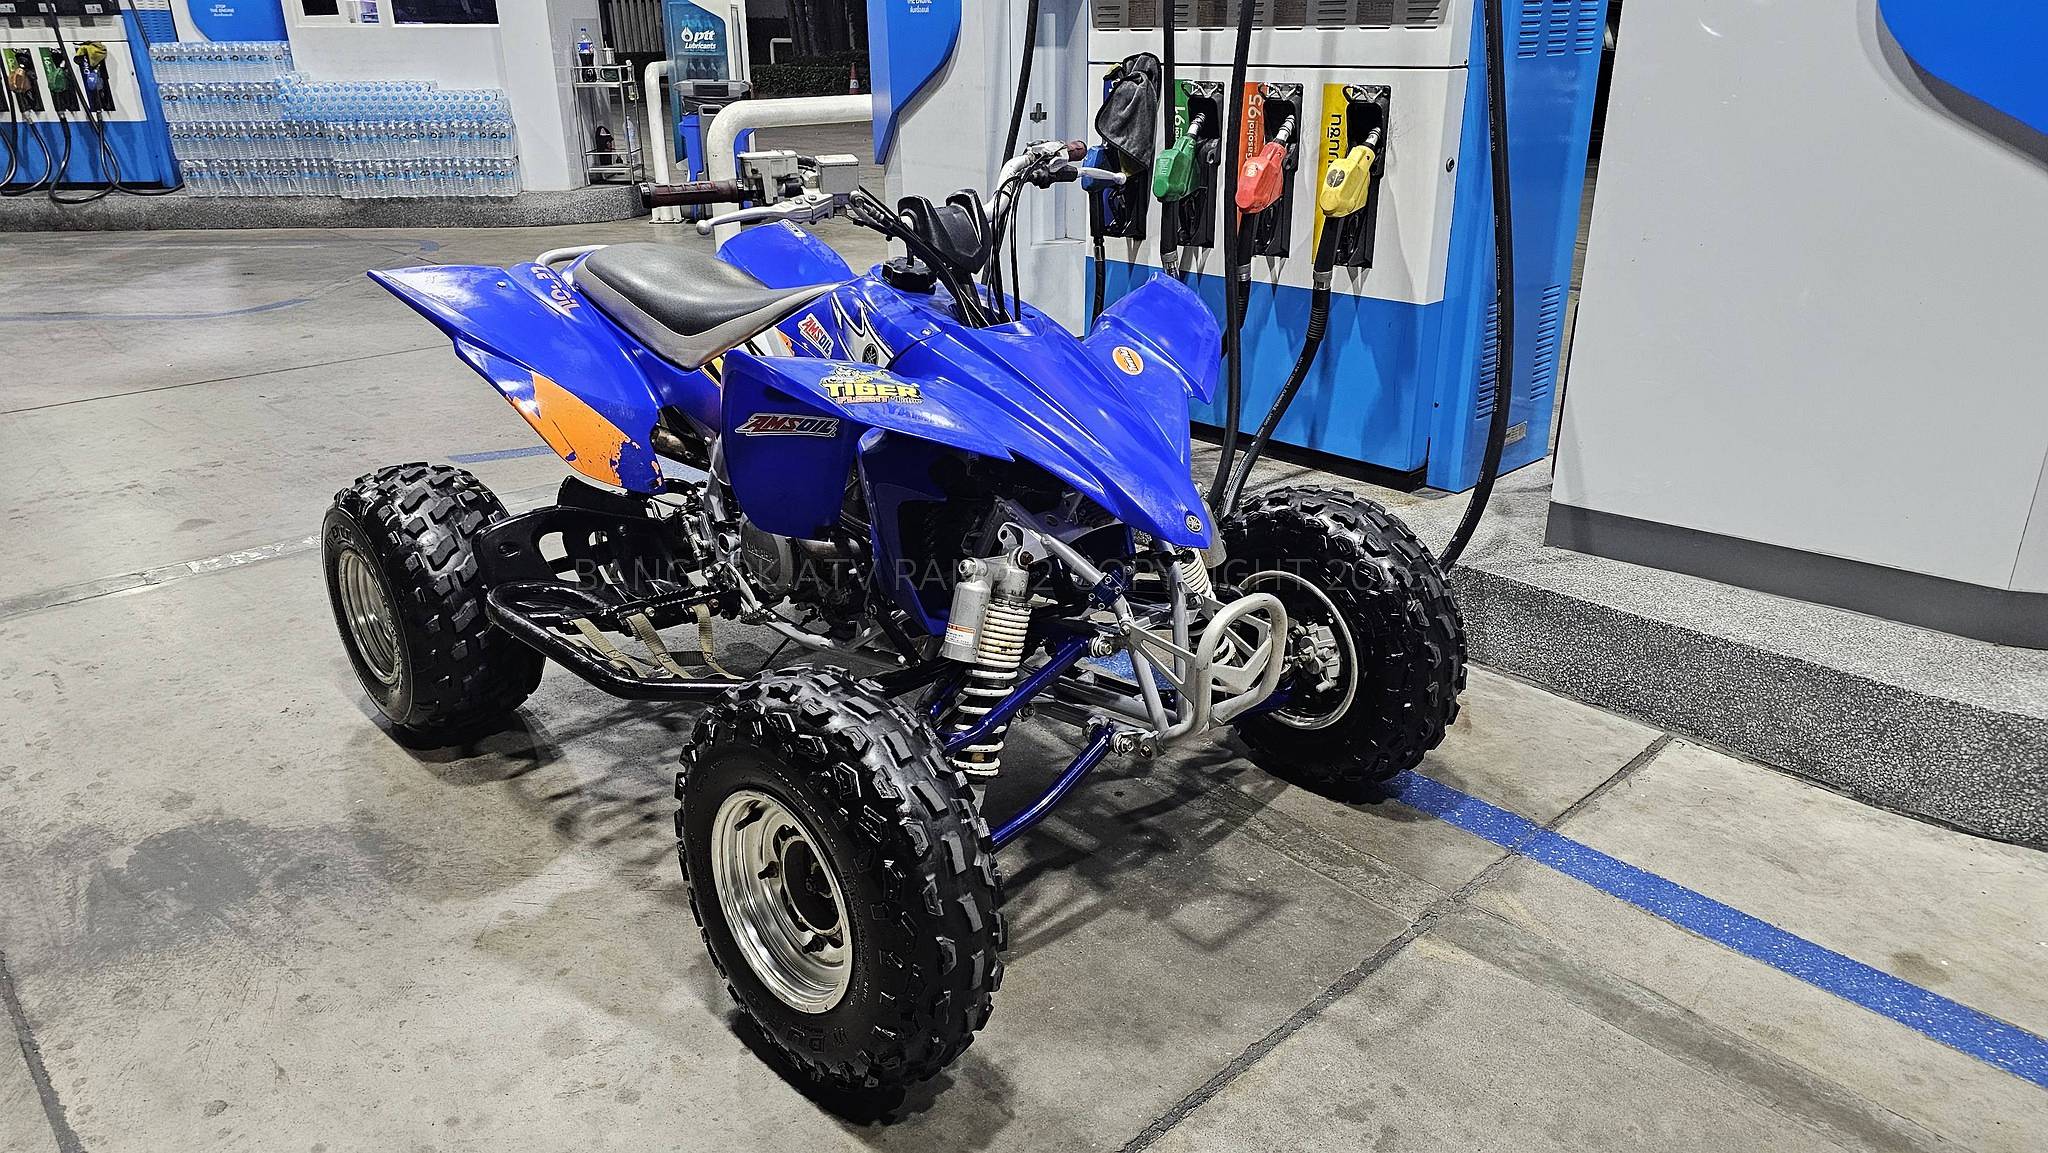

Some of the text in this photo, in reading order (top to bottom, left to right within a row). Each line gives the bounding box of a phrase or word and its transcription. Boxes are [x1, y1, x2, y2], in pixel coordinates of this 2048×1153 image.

[694, 30, 716, 42] ptt
[1174, 106, 1186, 126] 91
[1248, 94, 1263, 119] 95
[1246, 120, 1256, 160] Gasohol
[1326, 114, 1342, 168] บนซิน
[802, 316, 832, 355] AMSOIL
[825, 383, 918, 398] TIGER
[742, 415, 835, 434] AMSOIL
